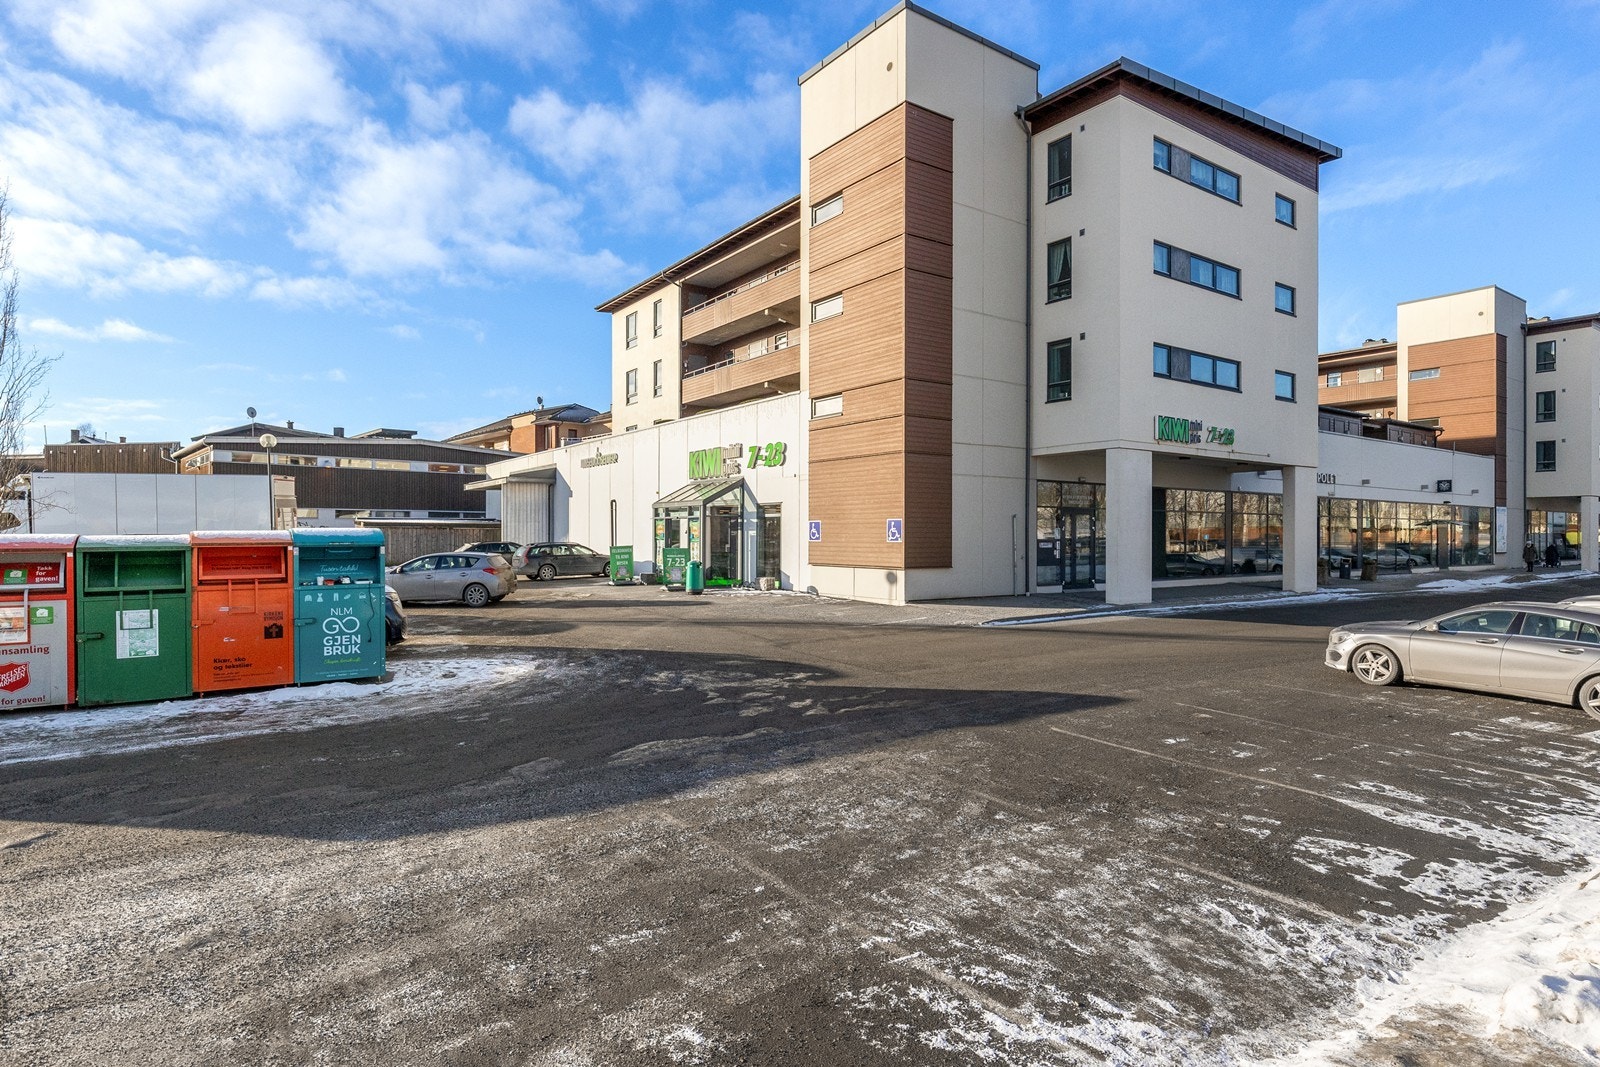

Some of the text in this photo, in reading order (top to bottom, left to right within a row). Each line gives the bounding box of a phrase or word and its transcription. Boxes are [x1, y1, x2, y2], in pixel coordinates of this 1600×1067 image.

[1156, 415, 1189, 444] KIWI
[747, 441, 787, 469] 7-23
[689, 446, 722, 480] KIWI
[666, 557, 686, 567] 7-23
[35, 575, 59, 583] gaven!
[330, 607, 353, 616] NLM
[323, 634, 361, 646] GJEN
[0, 645, 50, 655] nsamling
[323, 644, 361, 657] BRUK
[1, 695, 46, 706] for gaven!
